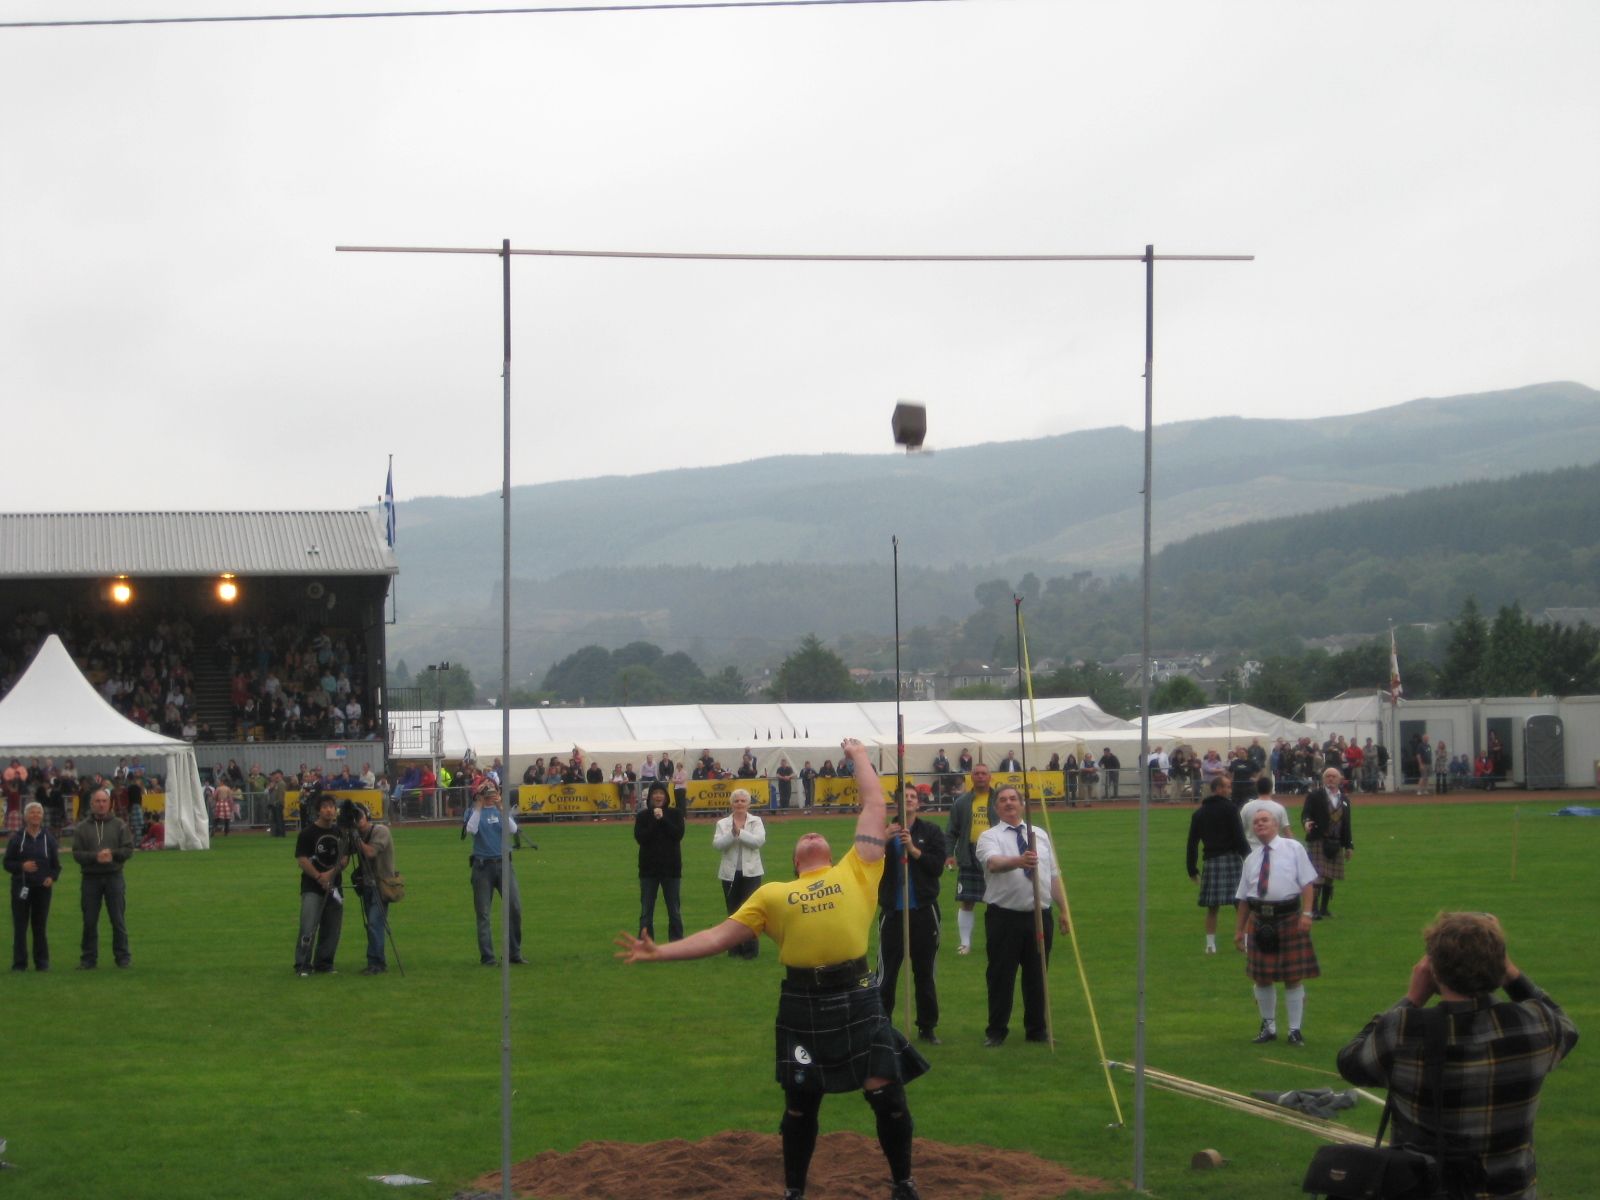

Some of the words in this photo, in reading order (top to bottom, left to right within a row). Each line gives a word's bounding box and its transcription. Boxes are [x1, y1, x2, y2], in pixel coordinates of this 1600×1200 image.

[548, 793, 589, 804] Corona
[699, 790, 732, 800] Coron
[787, 883, 842, 905] Corona
[802, 901, 835, 914] Extra
[800, 1049, 808, 1060] 2
